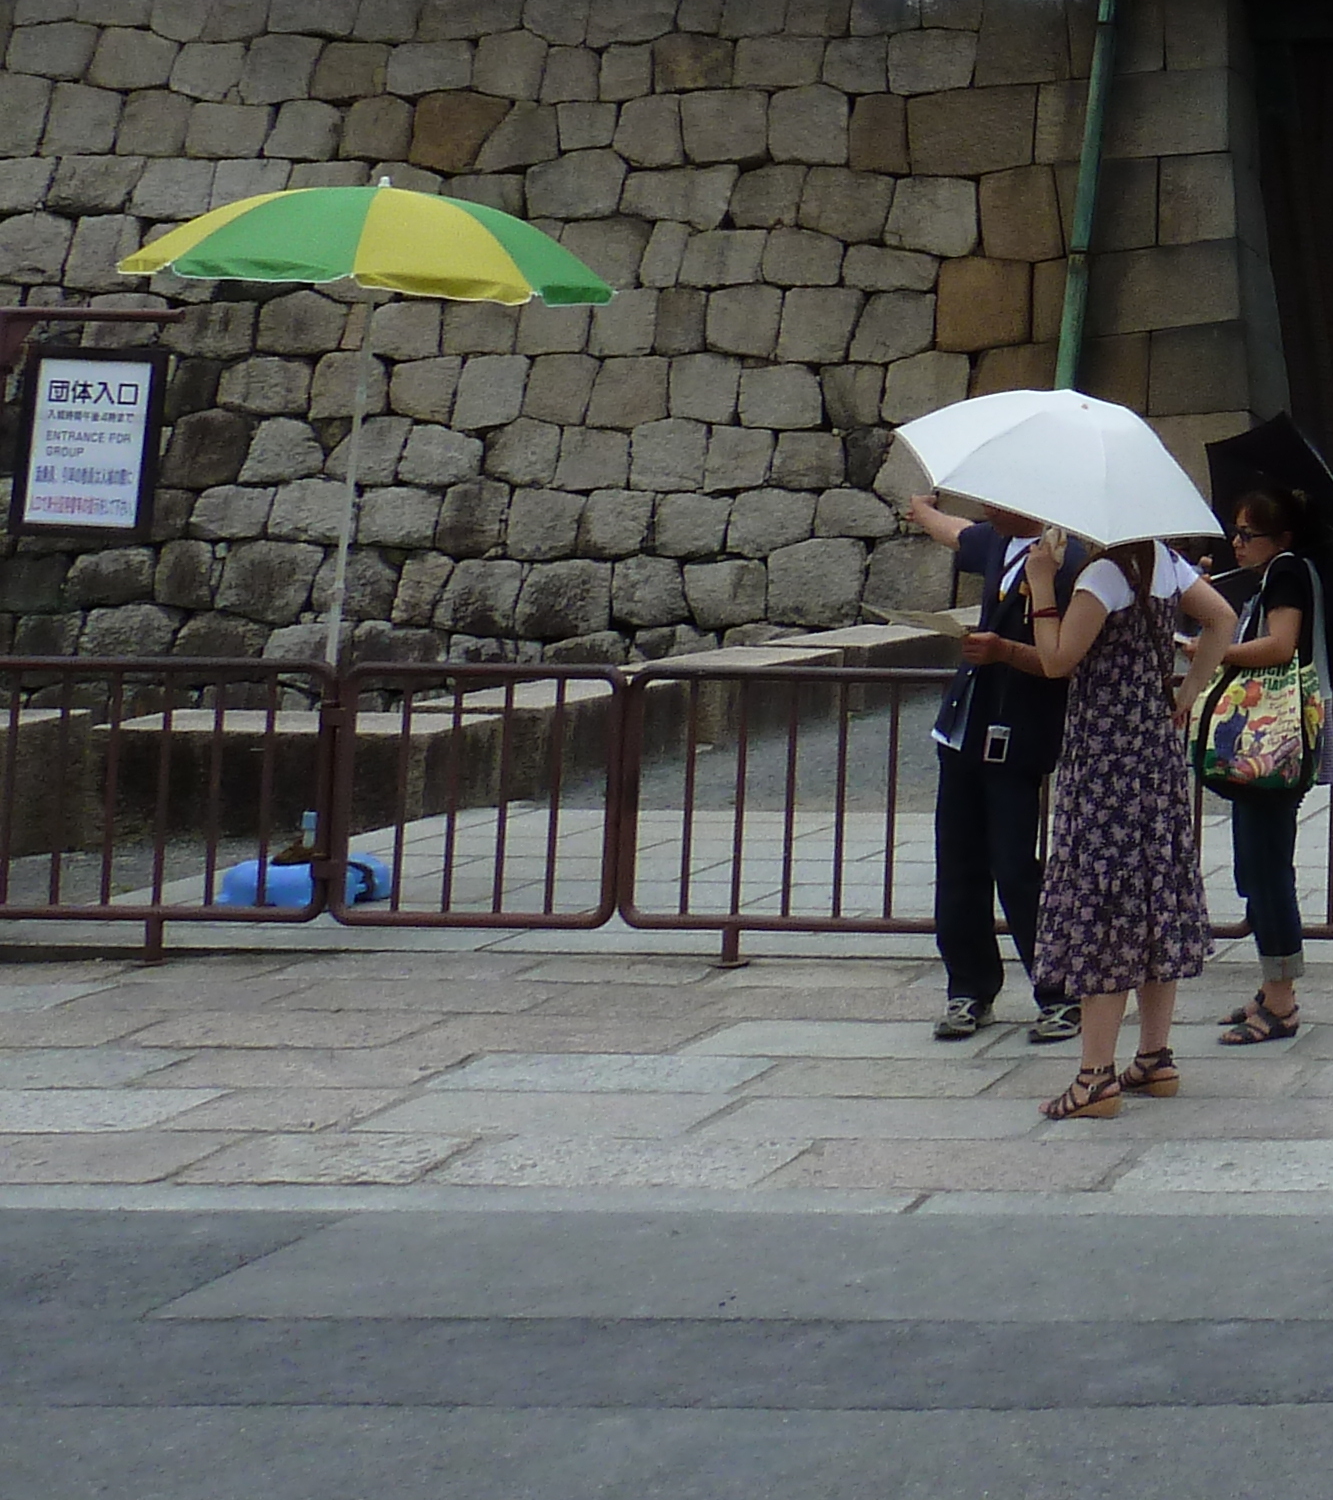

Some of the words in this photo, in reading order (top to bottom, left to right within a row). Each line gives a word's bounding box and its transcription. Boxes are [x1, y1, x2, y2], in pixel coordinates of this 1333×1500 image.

[48, 380, 138, 405] 団体入口
[46, 430, 105, 443] ENTRANCE
[108, 432, 131, 444] FOR
[45, 446, 84, 457] GROUP
